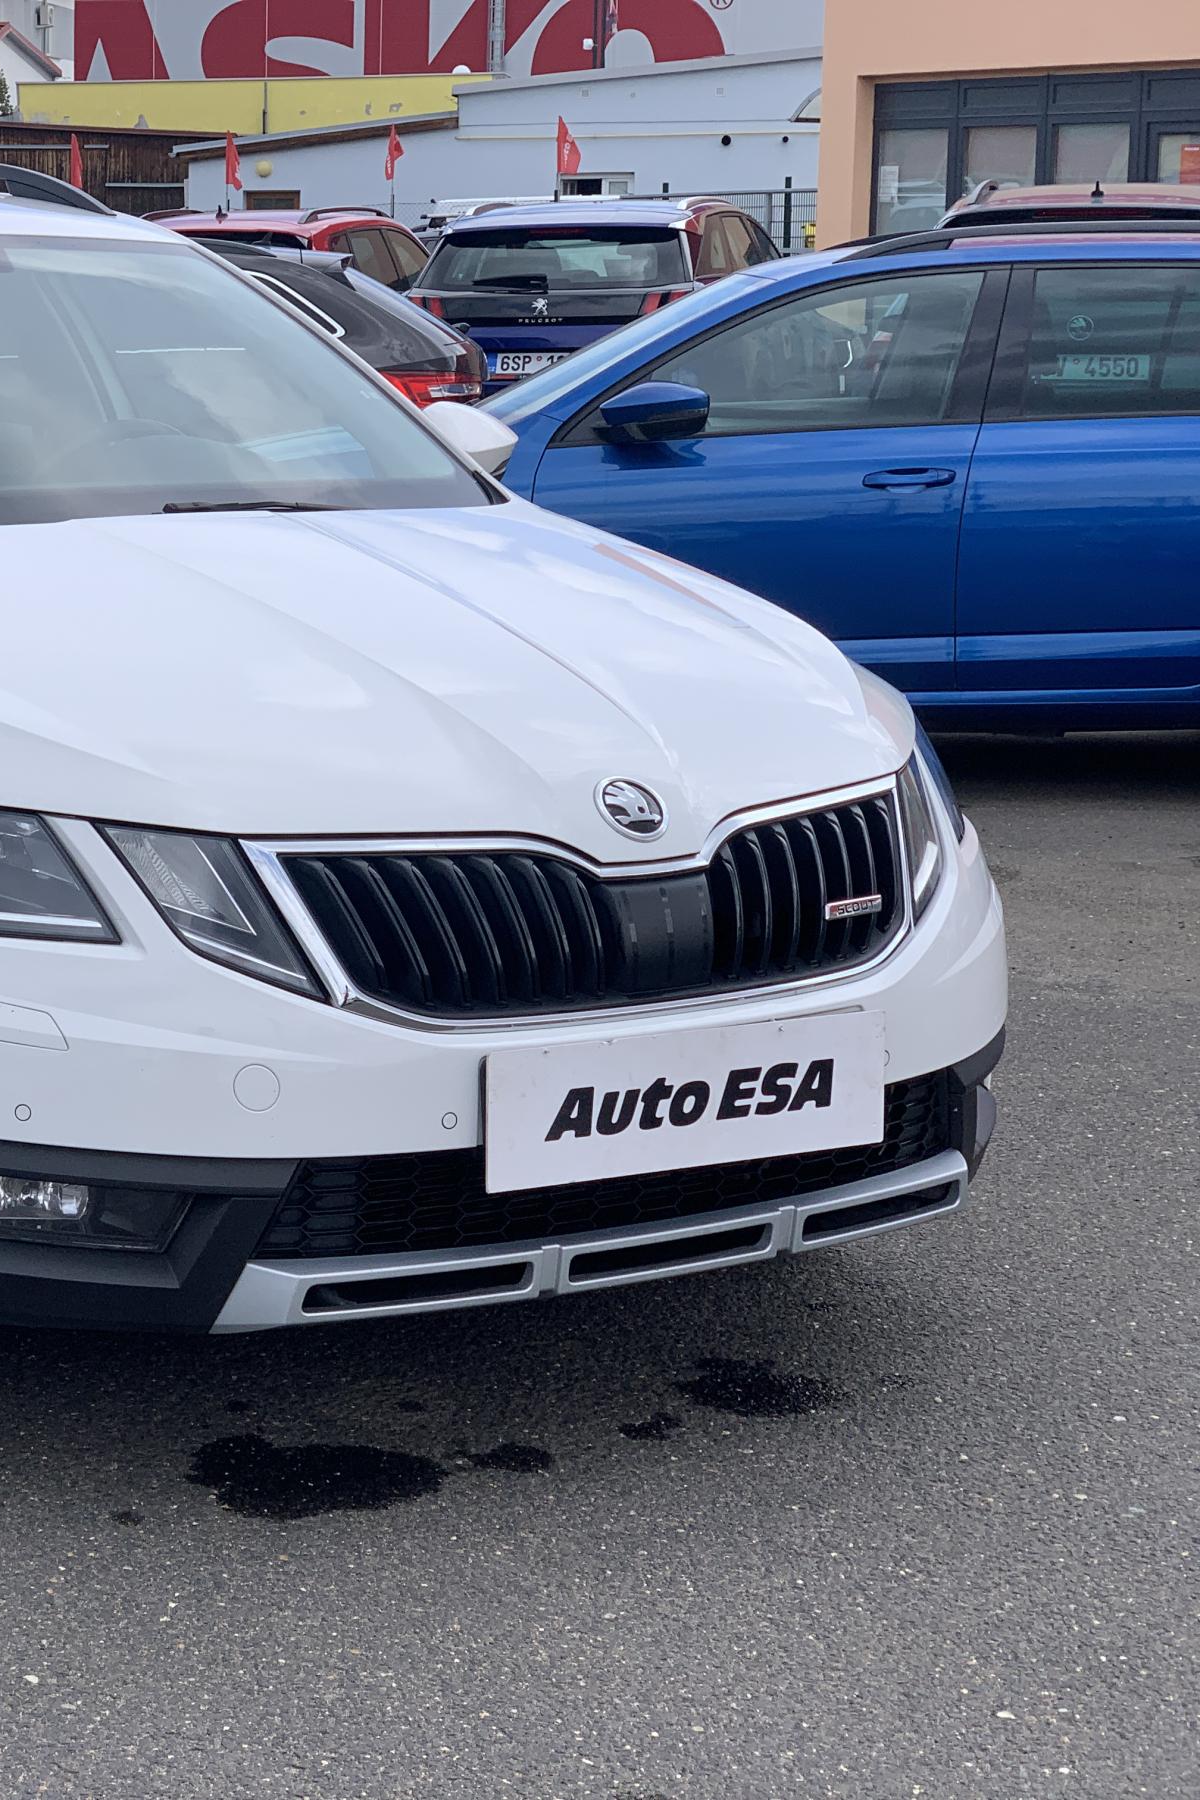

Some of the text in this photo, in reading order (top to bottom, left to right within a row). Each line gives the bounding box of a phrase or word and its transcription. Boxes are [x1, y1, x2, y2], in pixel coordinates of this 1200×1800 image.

[500, 355, 532, 372] 6SP
[1084, 356, 1139, 378] 4550
[837, 899, 875, 915] SCOUT
[544, 1058, 834, 1142] Auto ESA
